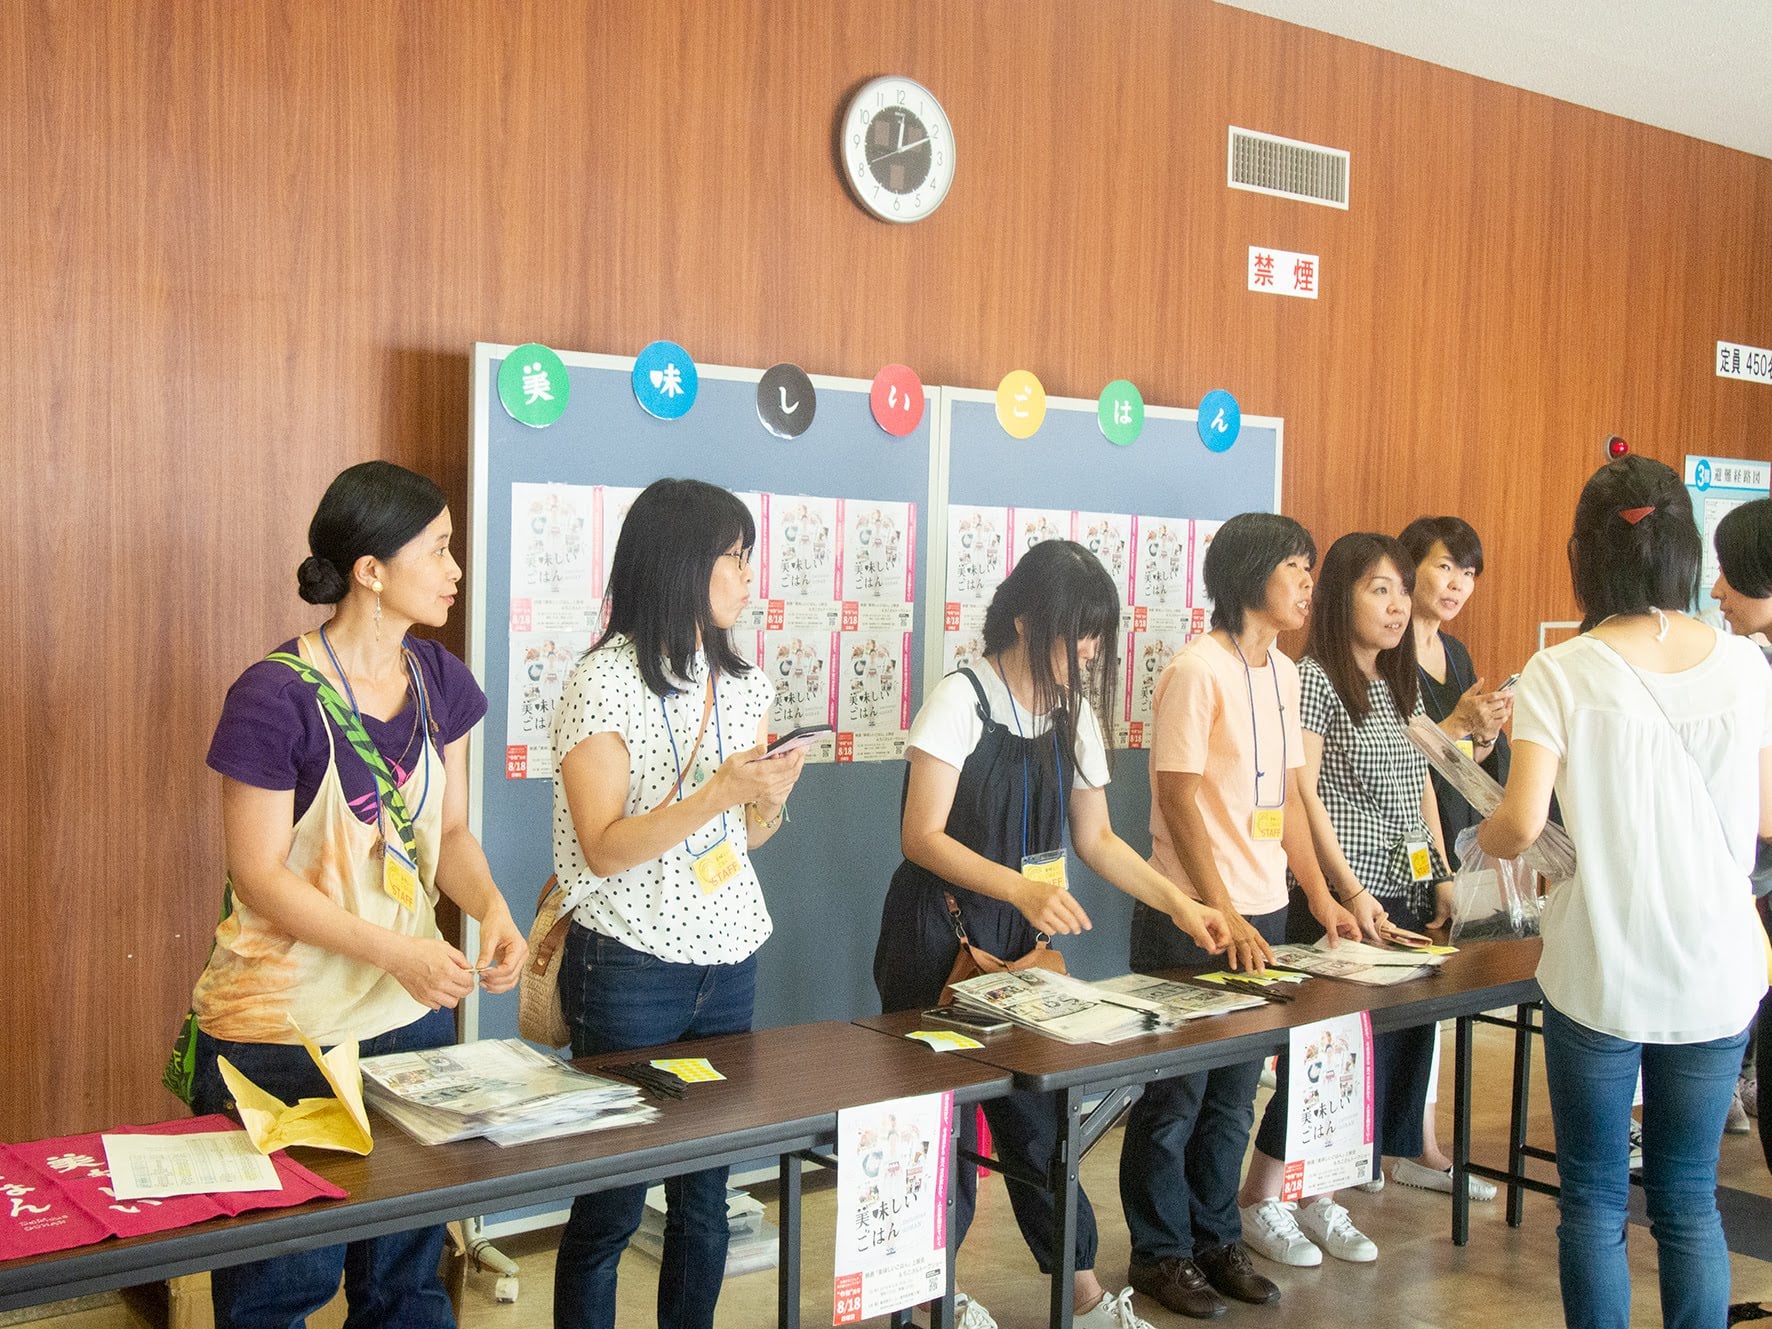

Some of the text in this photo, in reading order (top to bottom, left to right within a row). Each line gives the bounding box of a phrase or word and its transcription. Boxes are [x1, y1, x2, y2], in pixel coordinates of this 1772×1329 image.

[876, 92, 884, 107] 11
[896, 90, 906, 105] 12
[860, 109, 870, 125] 10
[931, 124, 940, 139] 2
[853, 134, 861, 149] 9
[936, 152, 944, 166] 3
[858, 162, 865, 177] 8
[929, 178, 937, 190] 4
[873, 186, 880, 199] 7
[893, 196, 901, 211] 6
[914, 194, 921, 208] 5
[1720, 347, 1741, 375] 定員
[857, 1222, 901, 1253] ごはん
